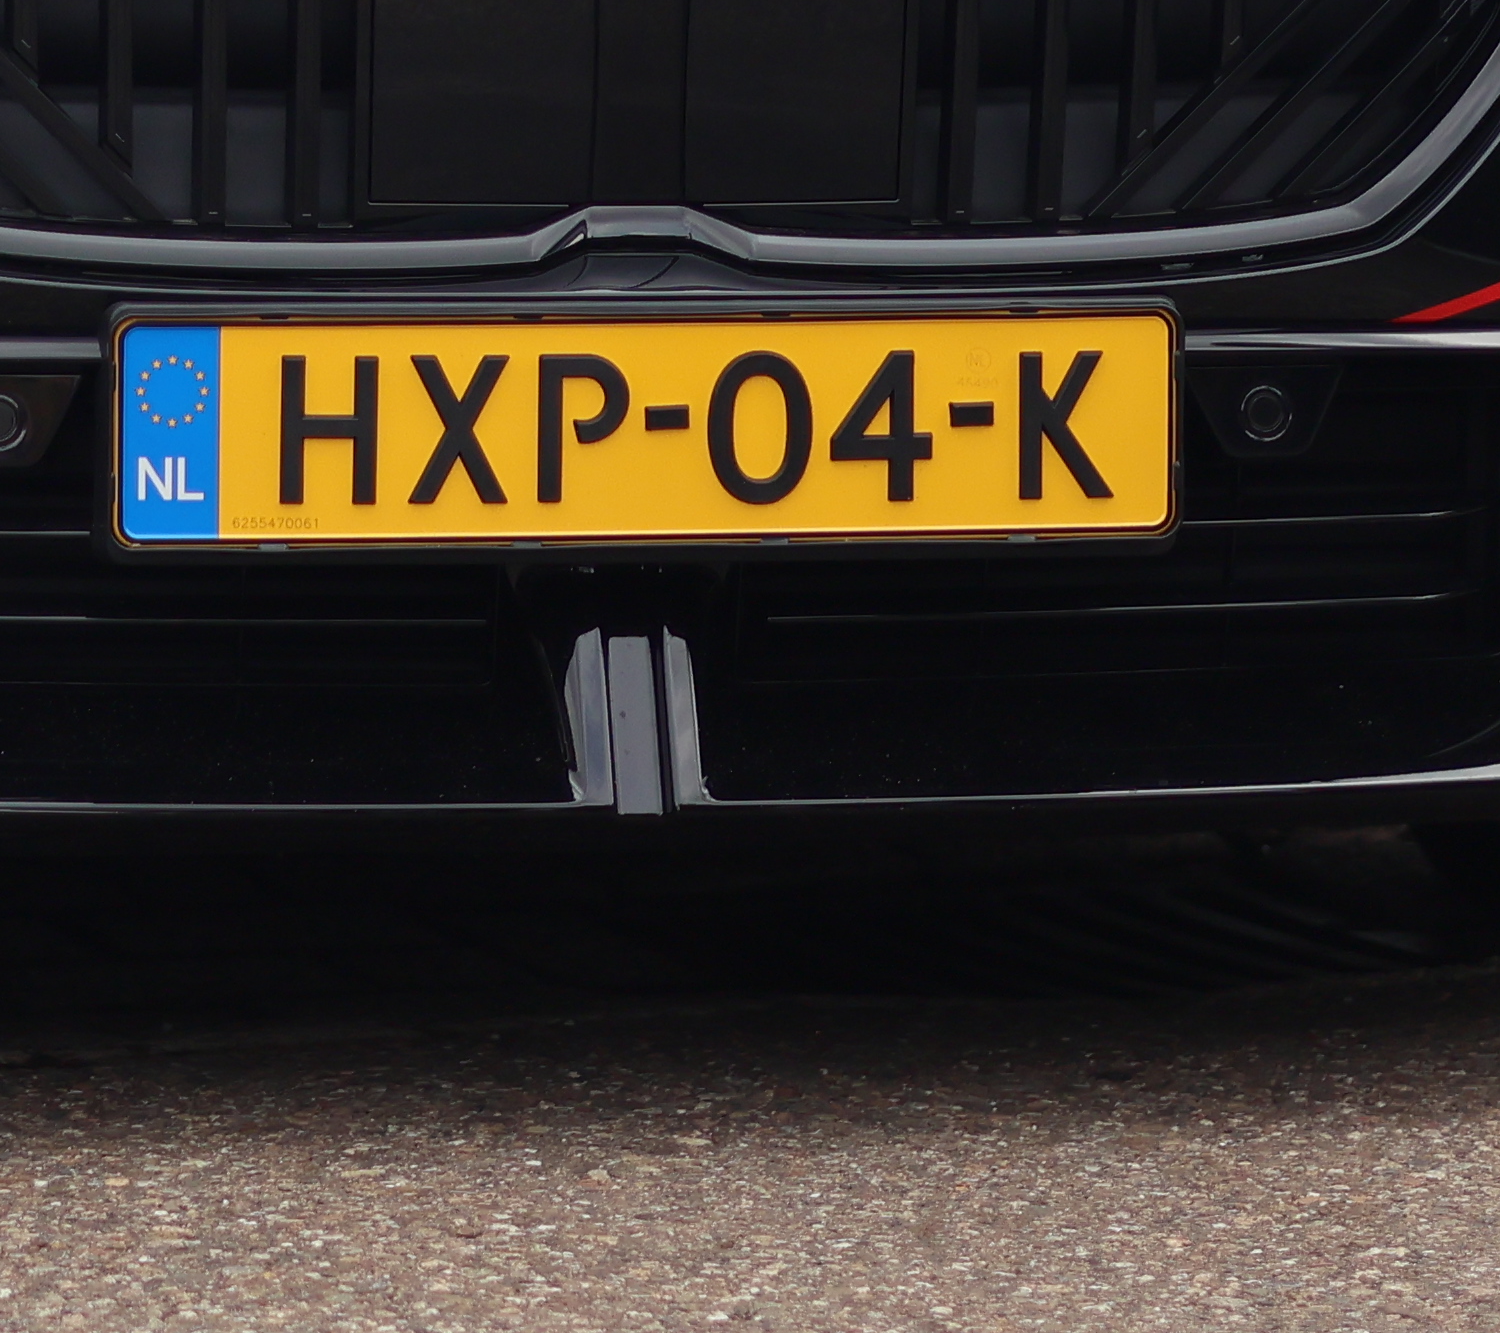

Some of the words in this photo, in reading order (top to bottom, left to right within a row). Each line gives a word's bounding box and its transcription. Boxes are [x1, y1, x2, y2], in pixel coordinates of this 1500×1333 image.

[279, 349, 1115, 506] HXP-04-K
[137, 456, 205, 501] NL
[231, 517, 320, 530] 6255470061
